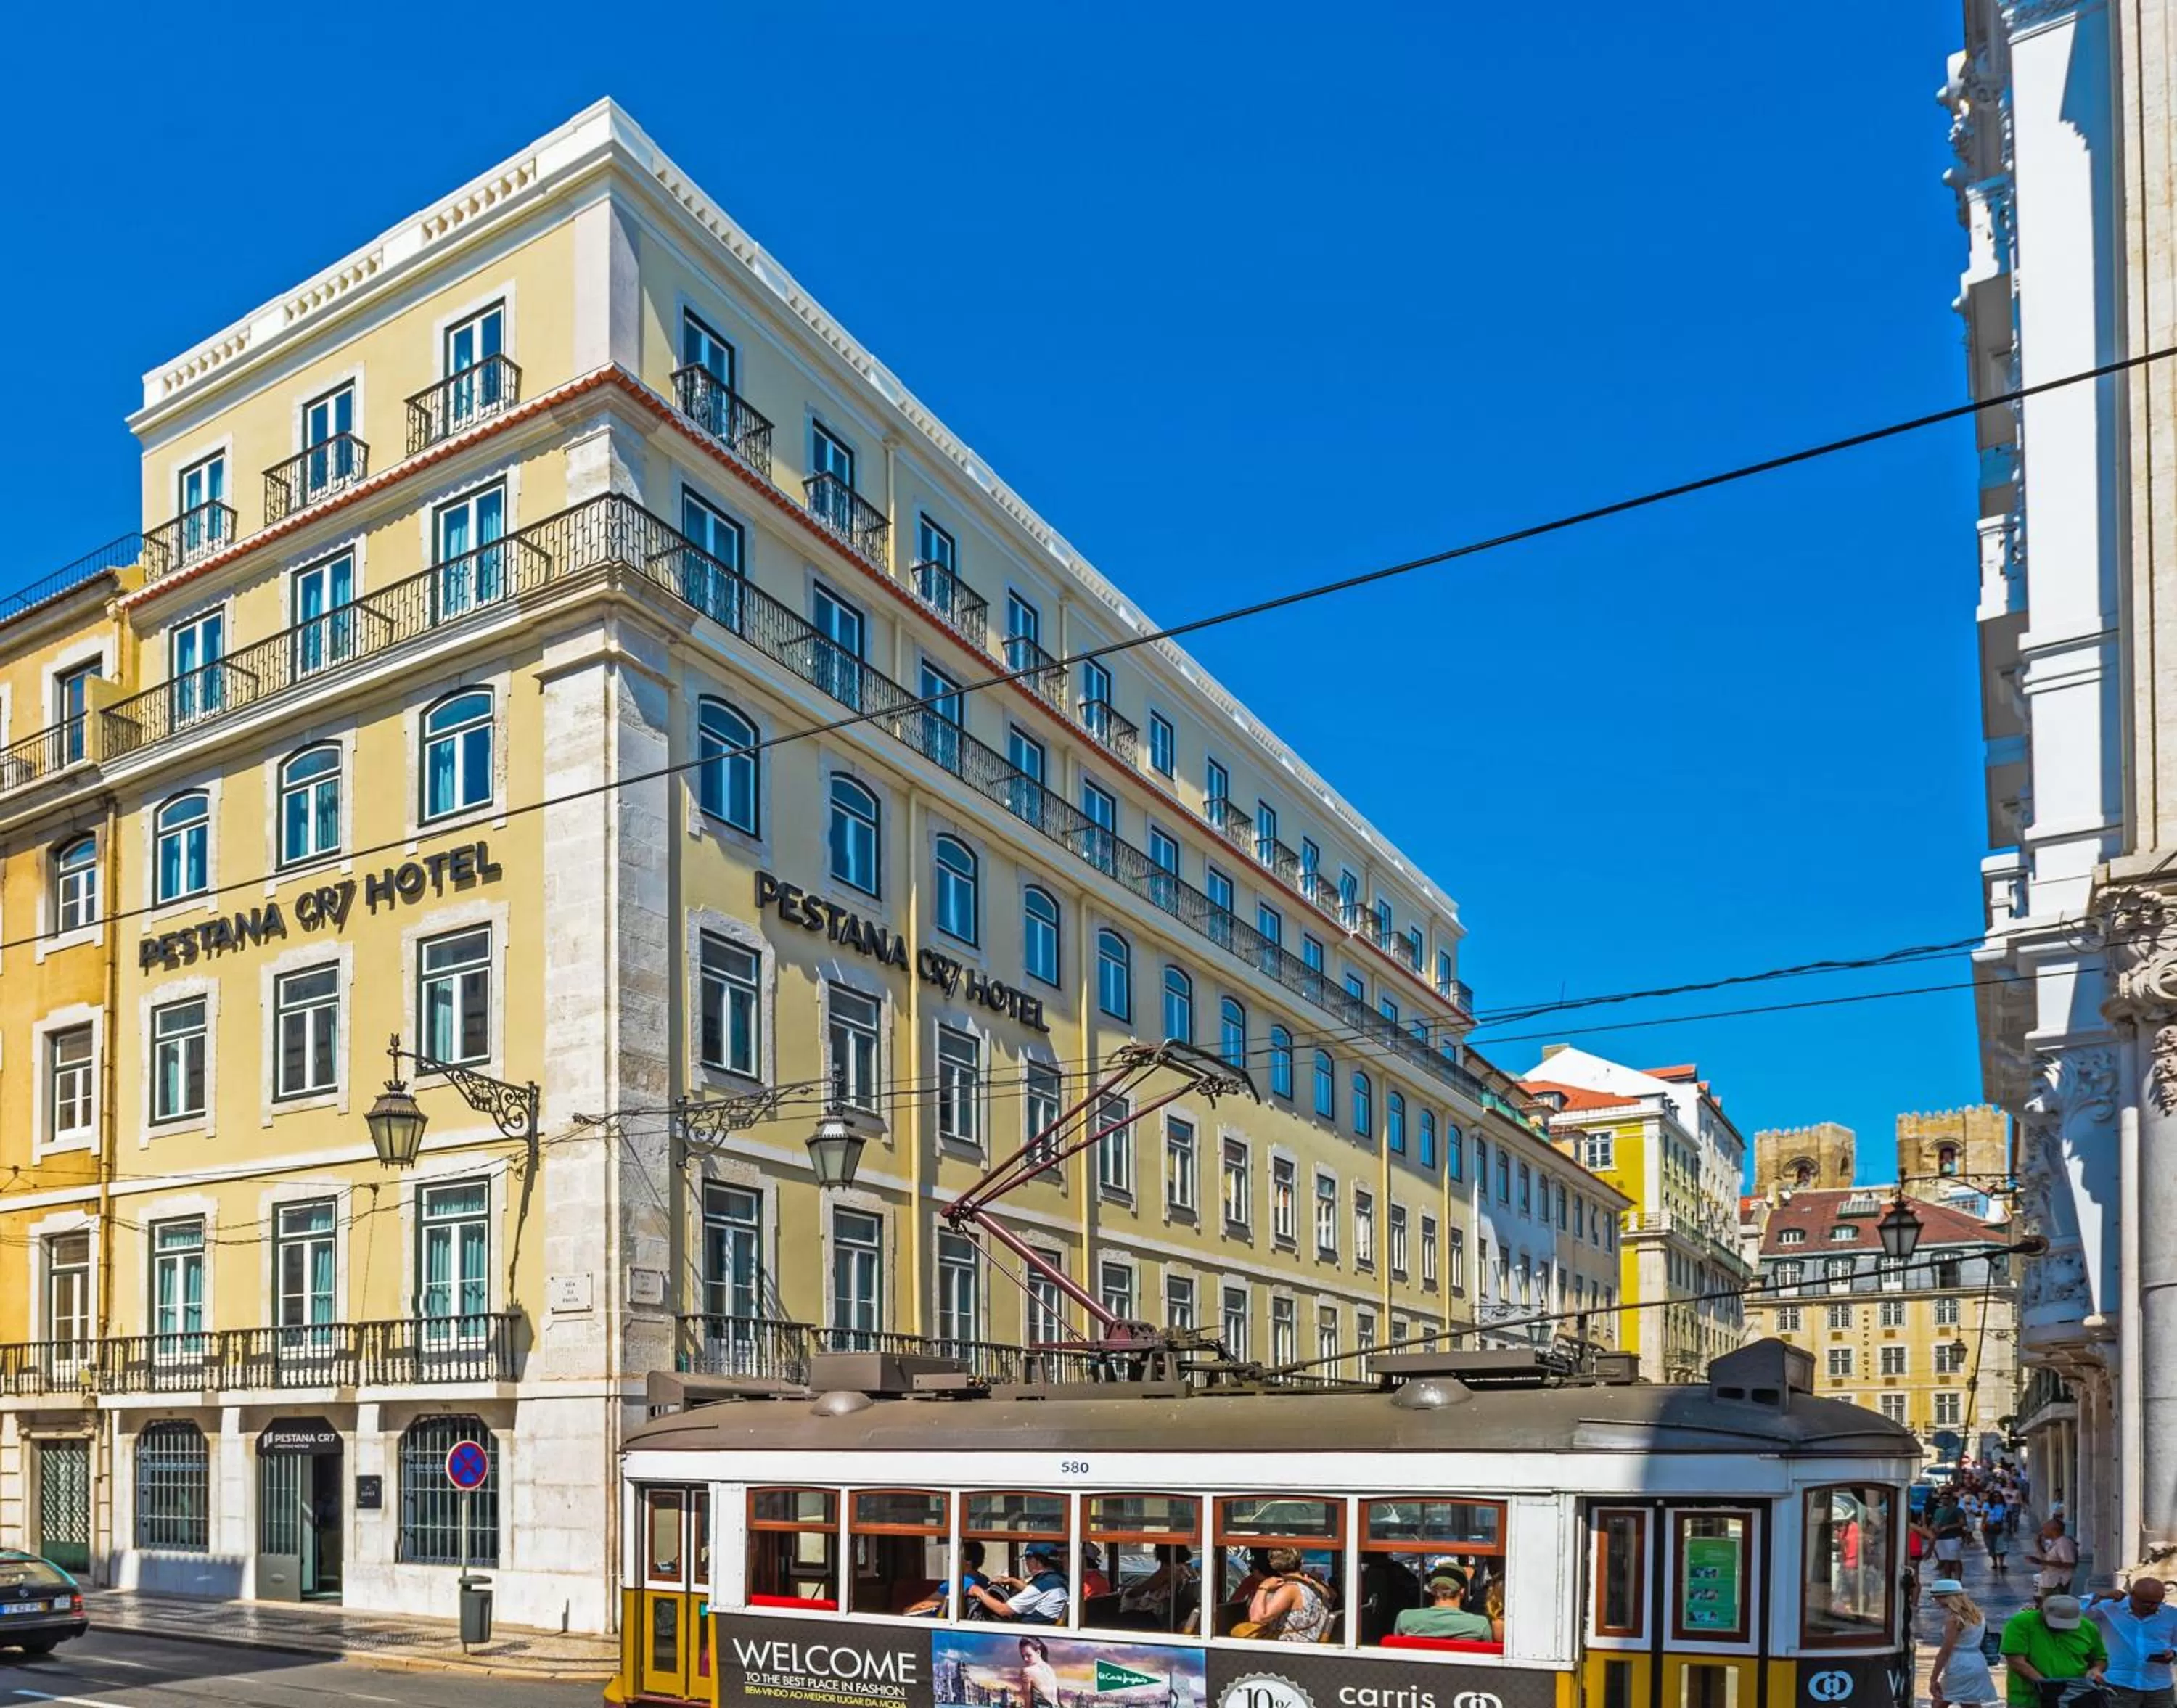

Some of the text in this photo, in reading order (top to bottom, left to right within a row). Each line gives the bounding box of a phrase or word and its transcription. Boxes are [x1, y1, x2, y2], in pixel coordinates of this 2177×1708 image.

[139, 841, 501, 972] PESTANA CR7 HOTEL
[755, 871, 1050, 1032] PESTANA CR7 HOTEL
[274, 1433, 335, 1442] PESTANA CR7
[1062, 1461, 1089, 1474] 580
[732, 1638, 917, 1683] WELCOME
[745, 1671, 905, 1697] TO THE BEST PLACE IN FASHION
[745, 1686, 788, 1698] BEM-VINDO
[790, 1690, 803, 1699] AO
[803, 1691, 836, 1703] MELHOR
[864, 1698, 878, 1708] DA
[1339, 1685, 1435, 1708] carris
